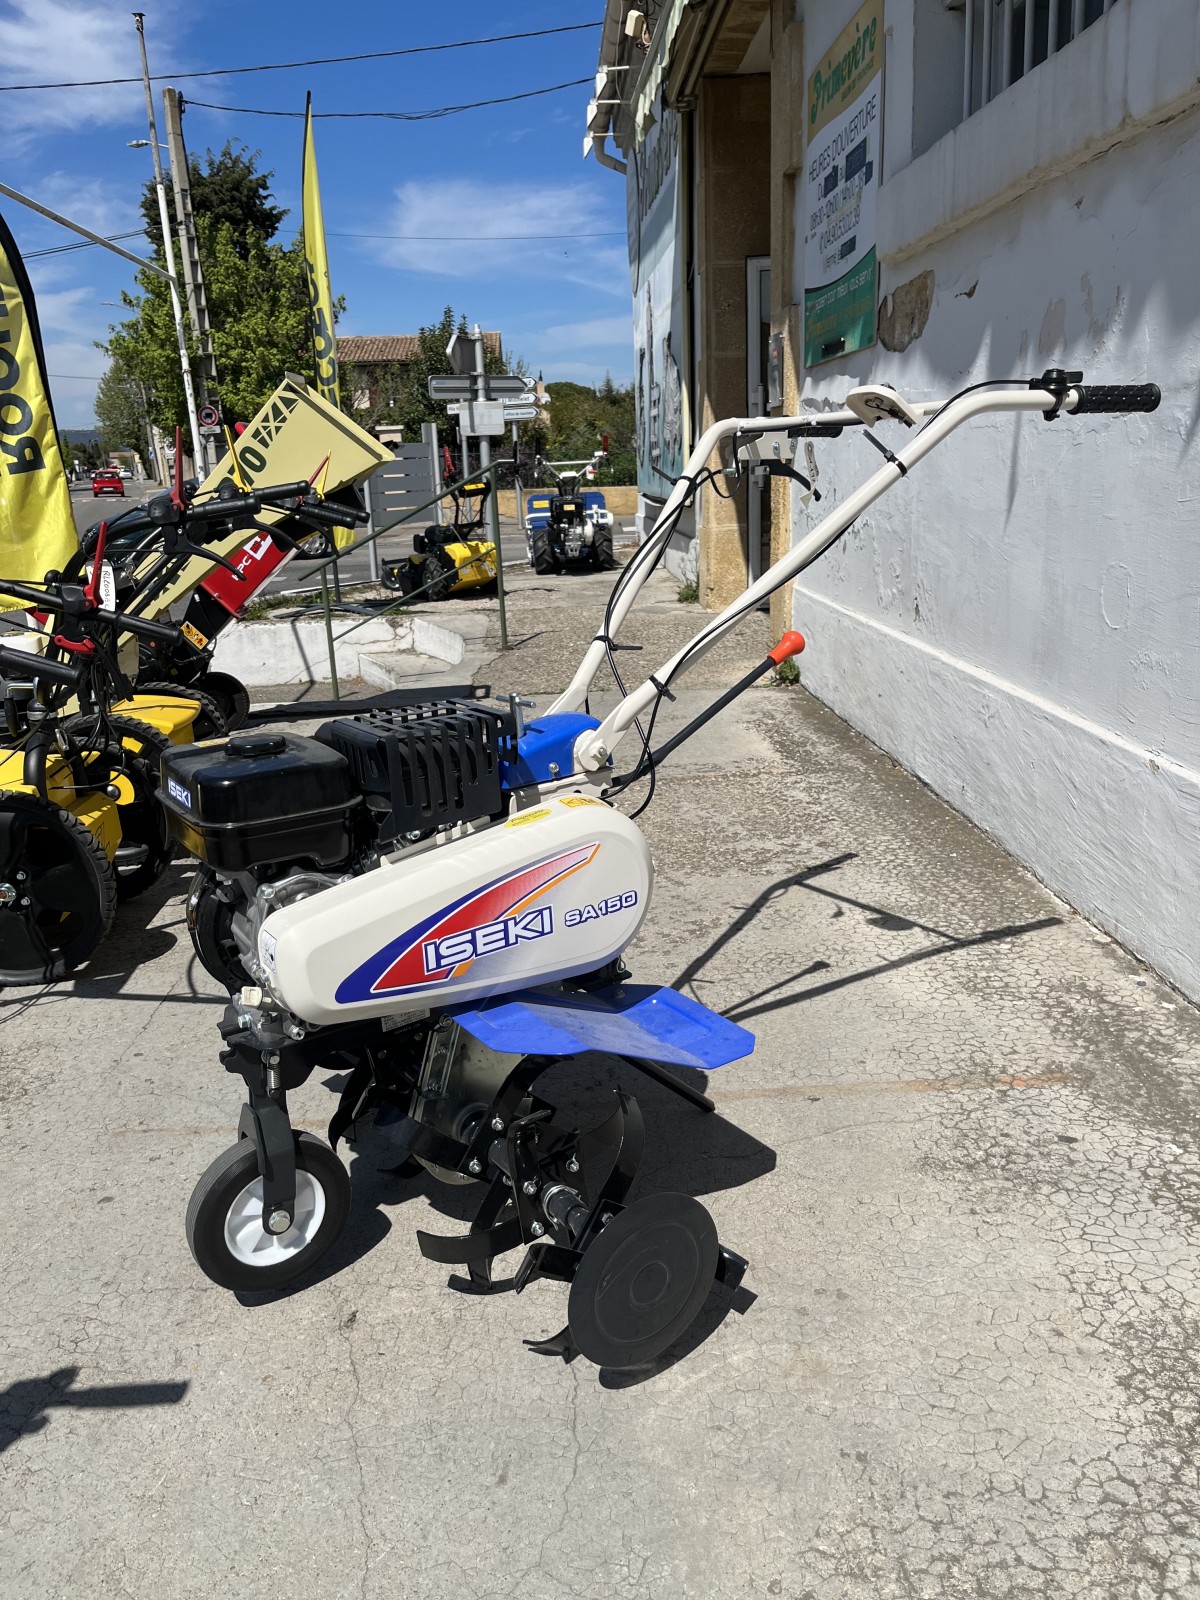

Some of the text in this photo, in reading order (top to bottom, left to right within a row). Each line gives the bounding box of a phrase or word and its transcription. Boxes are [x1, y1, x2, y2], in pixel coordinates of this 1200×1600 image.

[811, 16, 877, 124] Primevère
[808, 144, 830, 185] HEURES
[167, 777, 192, 809] ISEKI
[423, 890, 638, 974] ISEKI SA150
